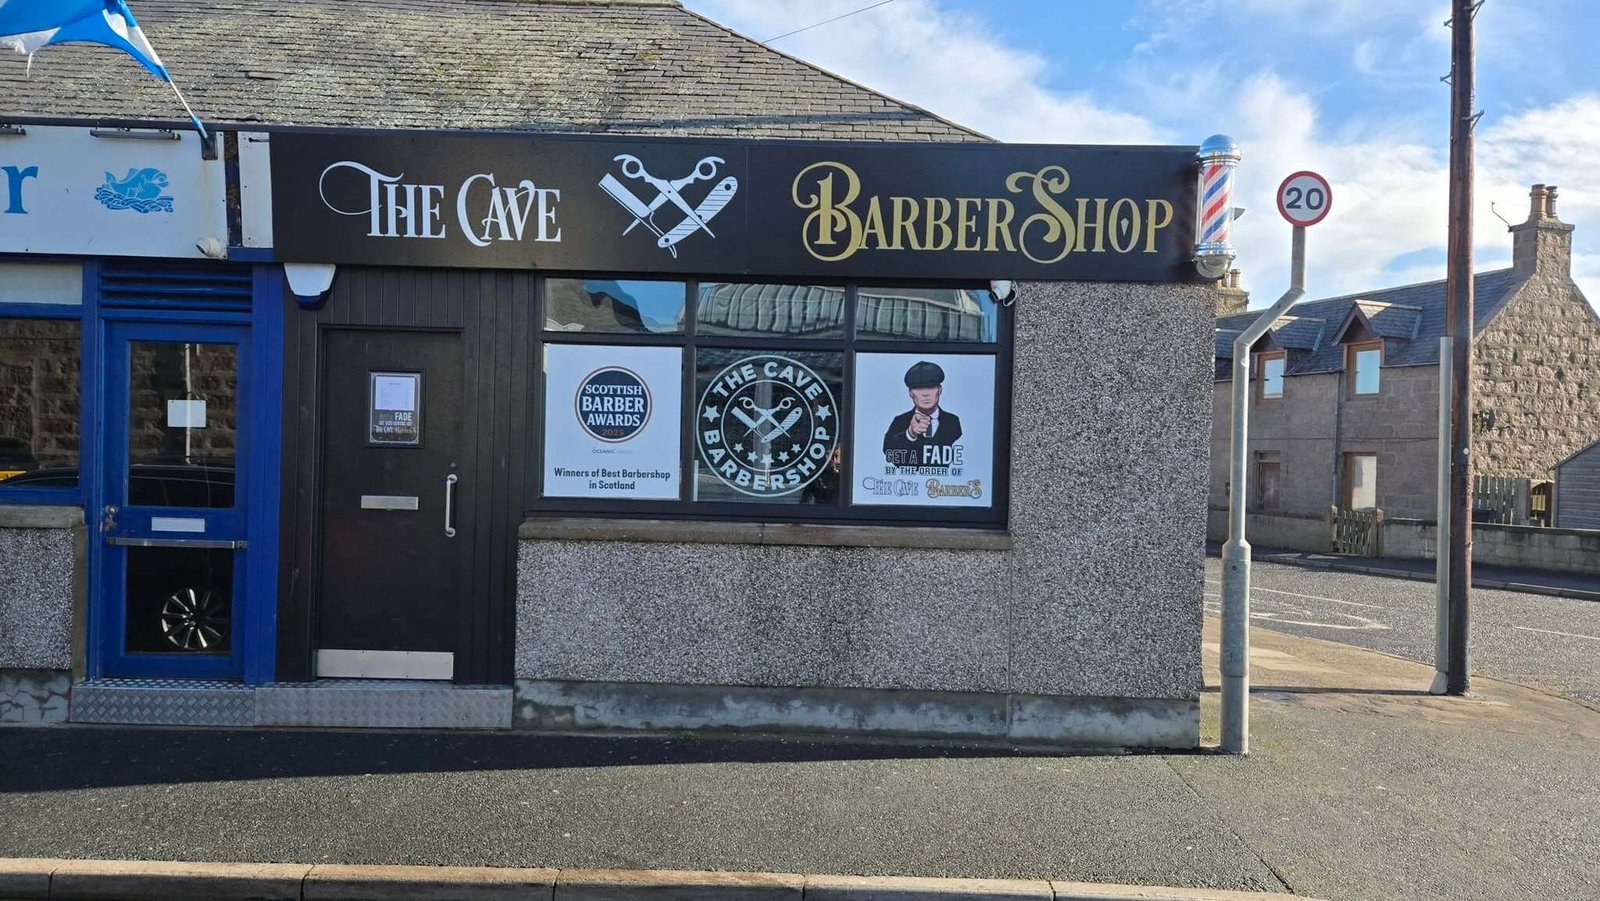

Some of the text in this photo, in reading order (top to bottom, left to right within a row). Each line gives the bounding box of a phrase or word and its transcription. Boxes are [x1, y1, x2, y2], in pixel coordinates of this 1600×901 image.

[1286, 187, 1324, 210] 20
[457, 173, 562, 247] CAVE
[712, 361, 824, 401] THE CAVE
[585, 384, 643, 395] SCOTTISH
[582, 396, 645, 413] BARBER
[394, 412, 412, 421] FADE
[587, 413, 641, 427] AWARDS
[703, 426, 831, 491] BARBERSHOP
[922, 444, 964, 466] FADE
[554, 467, 671, 481] Winners of Best Barbershop
[885, 466, 962, 476] BY THE ORDER OF
[589, 480, 636, 490] in Scotland
